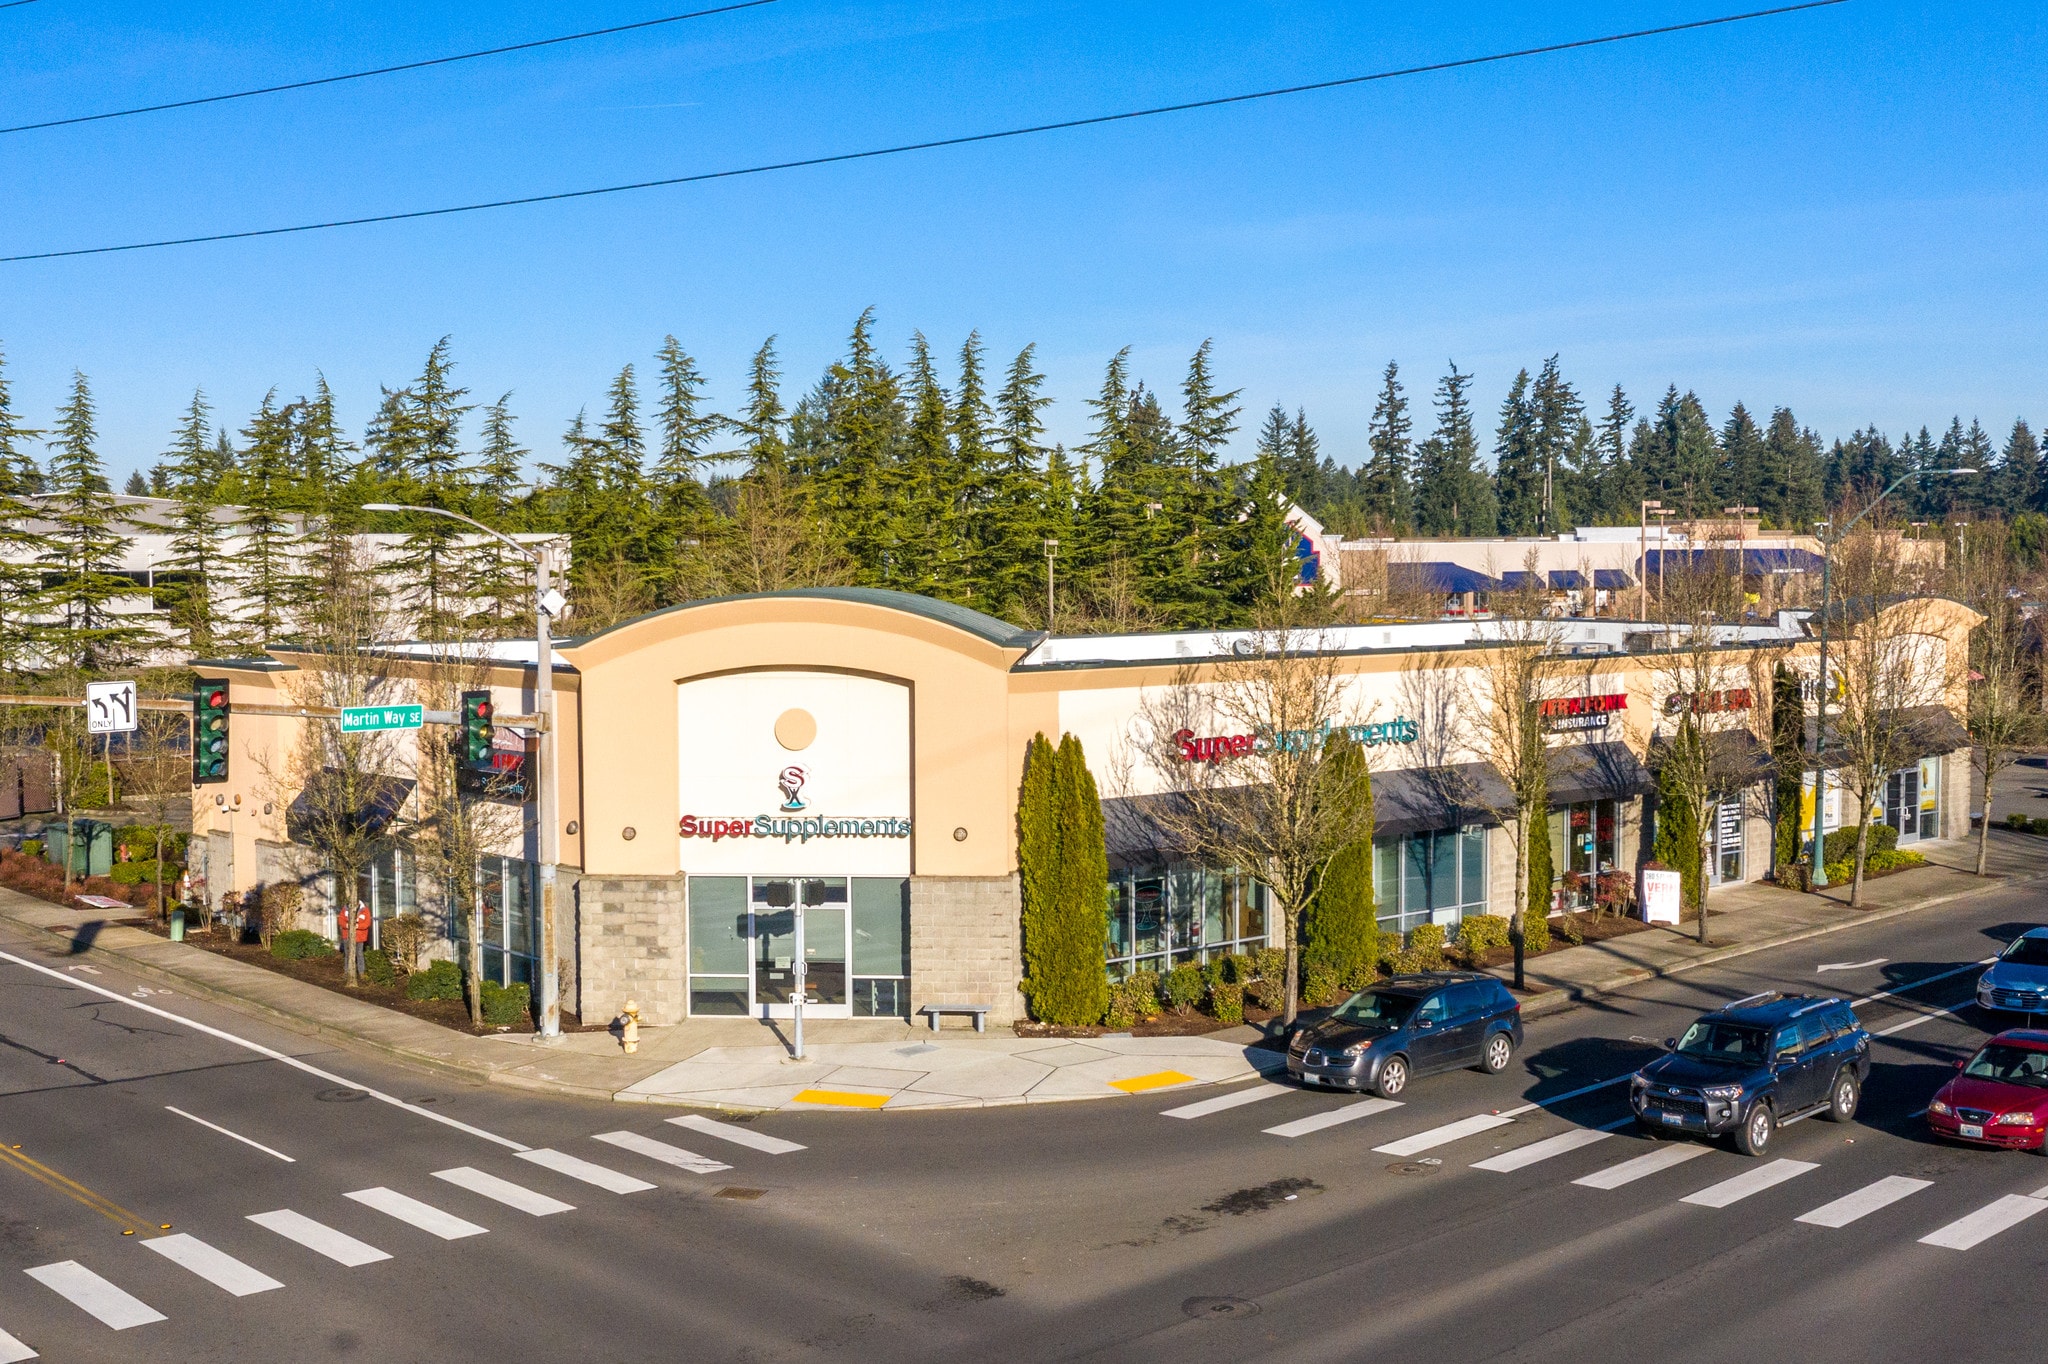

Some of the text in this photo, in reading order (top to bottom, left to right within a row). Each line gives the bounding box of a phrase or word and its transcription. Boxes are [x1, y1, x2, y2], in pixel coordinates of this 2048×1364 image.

[92, 720, 112, 729] ONLY
[344, 711, 420, 727] Martin Way SE
[1558, 714, 1607, 730] INSURANCE
